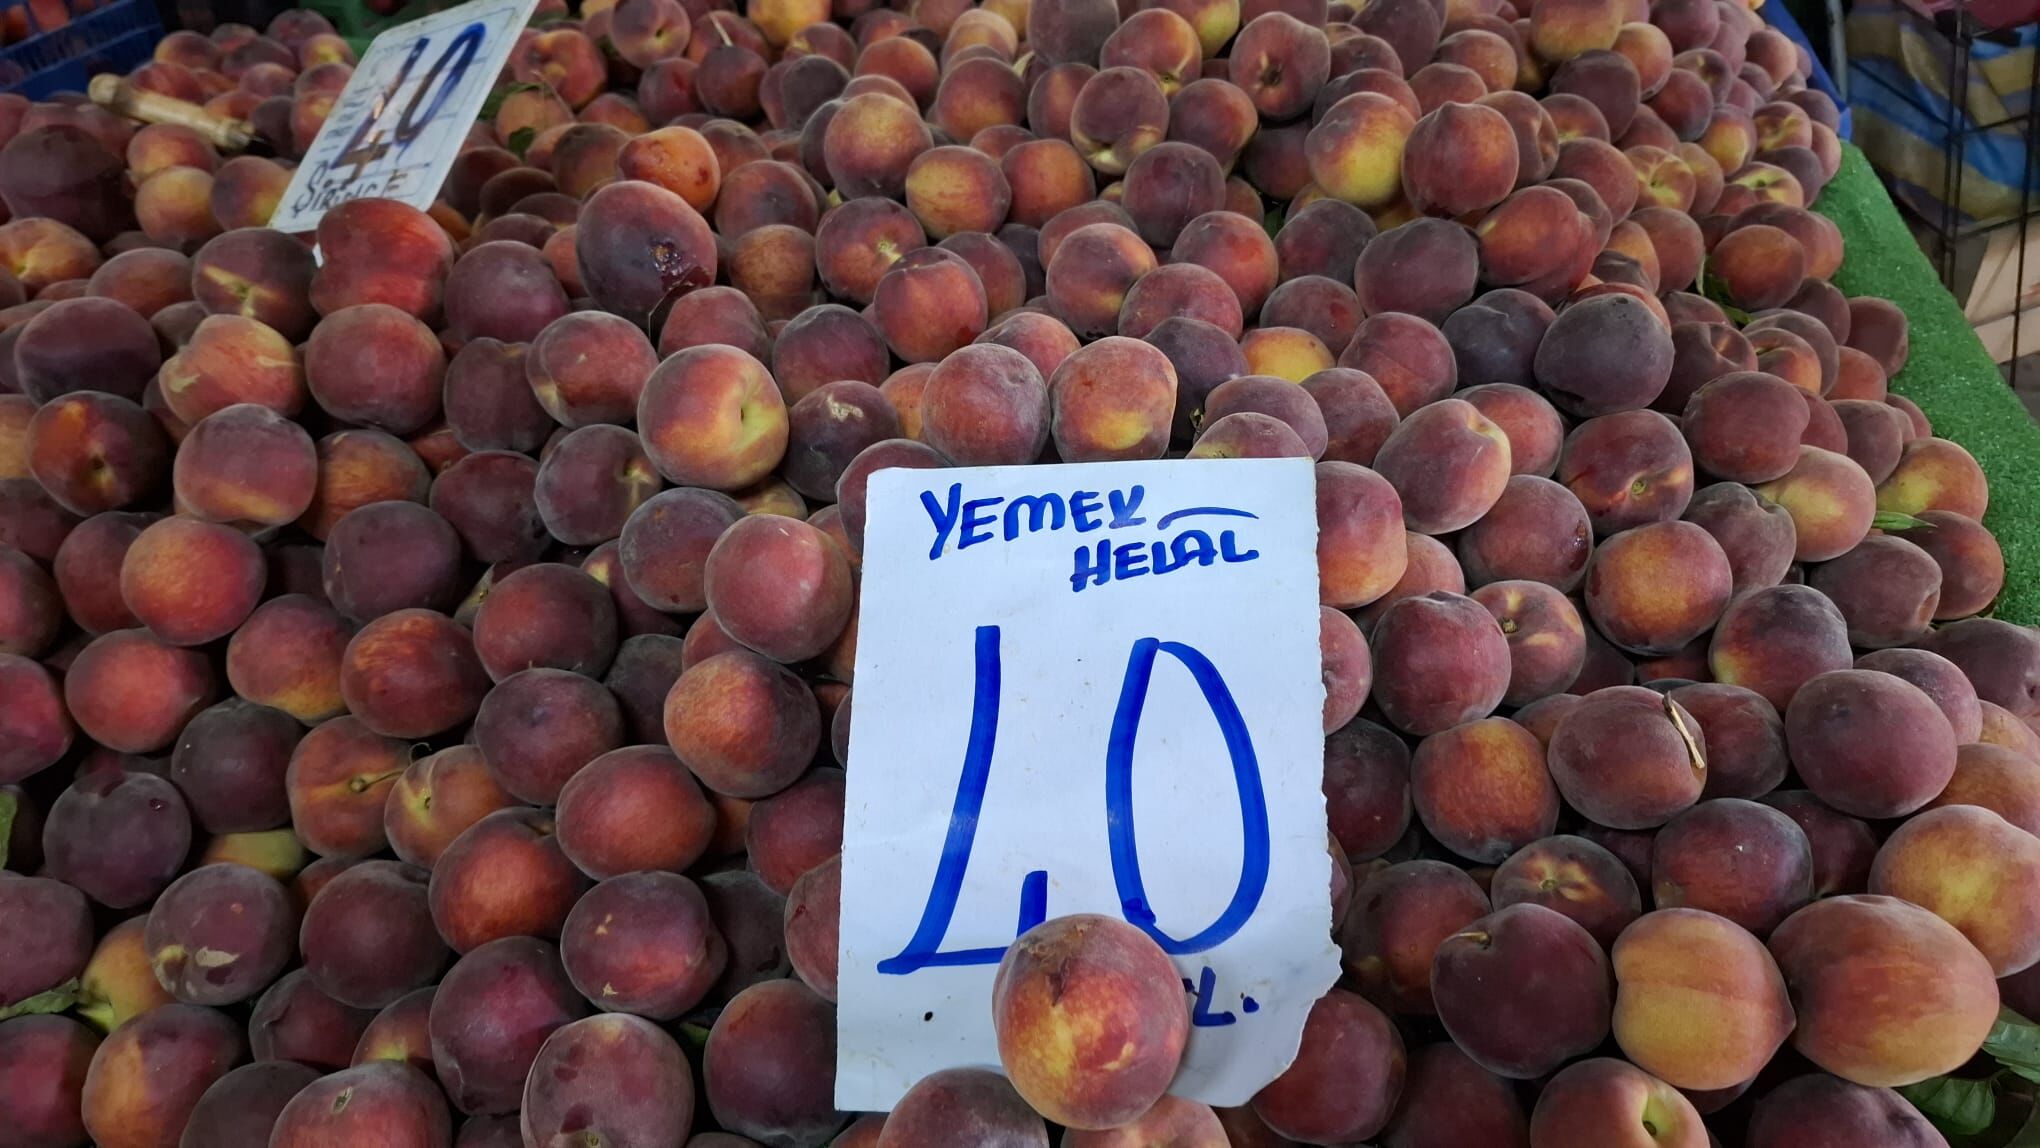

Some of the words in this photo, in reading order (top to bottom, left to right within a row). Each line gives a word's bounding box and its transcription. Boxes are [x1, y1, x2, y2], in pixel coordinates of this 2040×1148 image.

[920, 482, 1147, 560] YEMEK
[1070, 529, 1260, 592] HELAL
[877, 625, 1270, 974] 40
[1181, 965, 1260, 1027] L.
